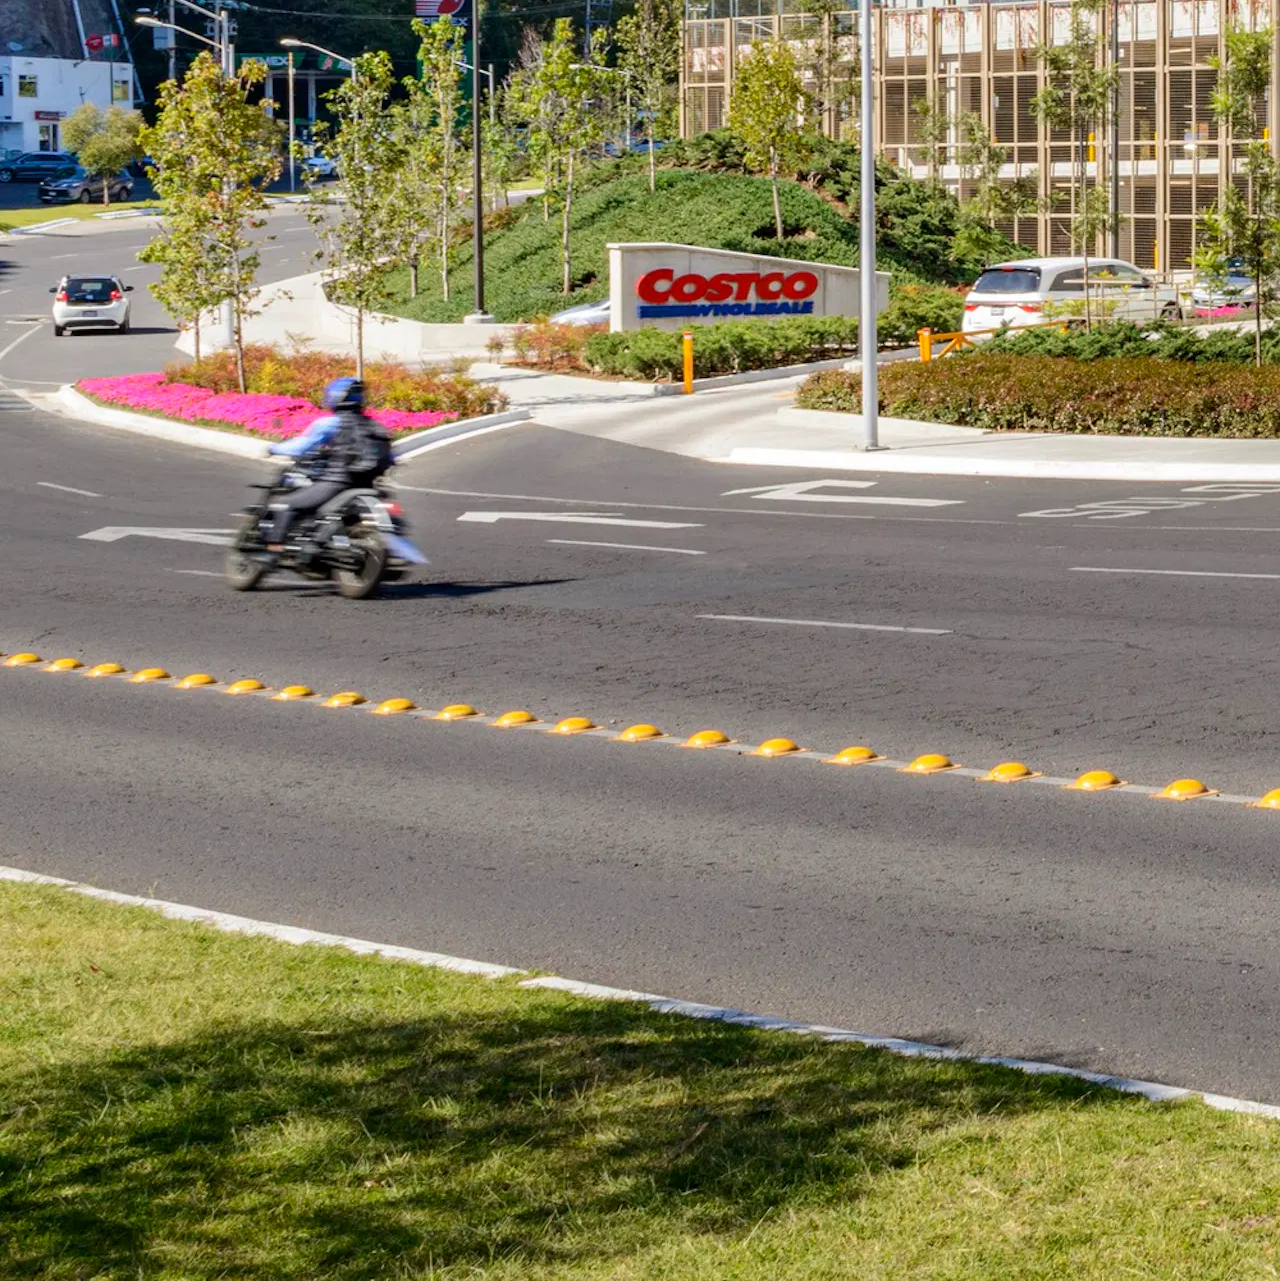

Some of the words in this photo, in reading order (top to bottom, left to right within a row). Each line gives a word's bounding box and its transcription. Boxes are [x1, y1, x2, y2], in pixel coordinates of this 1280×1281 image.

[422, 17, 468, 26] PEEX
[241, 56, 289, 66] MEX
[636, 268, 819, 304] COSTCO
[695, 301, 814, 317] WHOLESALE
